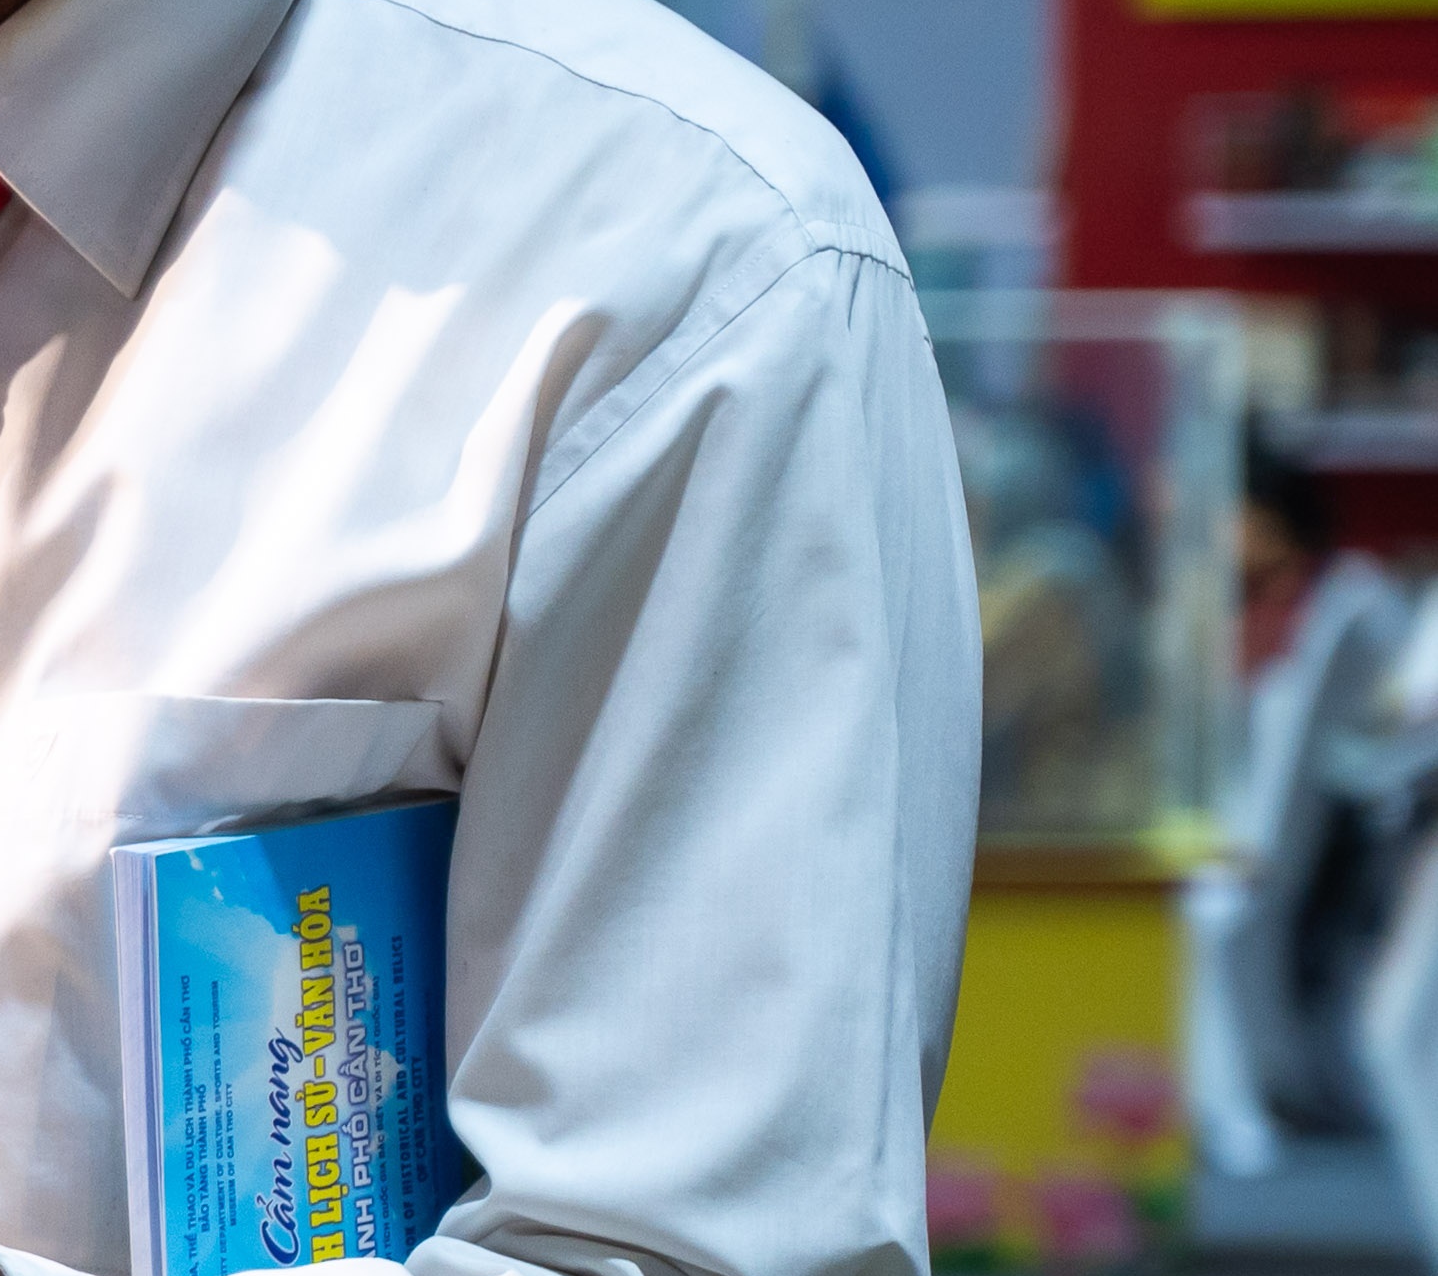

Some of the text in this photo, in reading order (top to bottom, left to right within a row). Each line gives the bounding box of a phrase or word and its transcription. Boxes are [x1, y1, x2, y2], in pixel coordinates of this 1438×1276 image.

[291, 885, 332, 970] HÓA
[342, 941, 366, 1018] THƠ
[391, 935, 404, 984] RELICS
[211, 980, 221, 1030] TOURISM
[295, 975, 335, 1055] VĂN
[392, 989, 408, 1065] CULTURAL
[213, 1033, 221, 1055] AND
[338, 1026, 370, 1104] CẦN
[394, 1070, 409, 1101] AND
[411, 1057, 424, 1089] CITY
[296, 1081, 339, 1127] SỬ
[413, 1092, 426, 1123] THO
[185, 1151, 195, 1170] DU
[197, 1116, 208, 1161] THÀNH
[225, 1083, 237, 1226] MUSEUM OF CAN THO CITY
[256, 1027, 303, 1265] Cẩm nang
[342, 1112, 373, 1187] PHỐ
[397, 1106, 414, 1195] HISTORICAL
[414, 1126, 427, 1159] CAN
[184, 1173, 195, 1191] VÀ
[216, 1163, 225, 1177] OF
[306, 1132, 349, 1228] LỊCH
[186, 1194, 197, 1230] THAO
[217, 1179, 227, 1253] DEPARTMENT
[402, 1200, 416, 1220] OF
